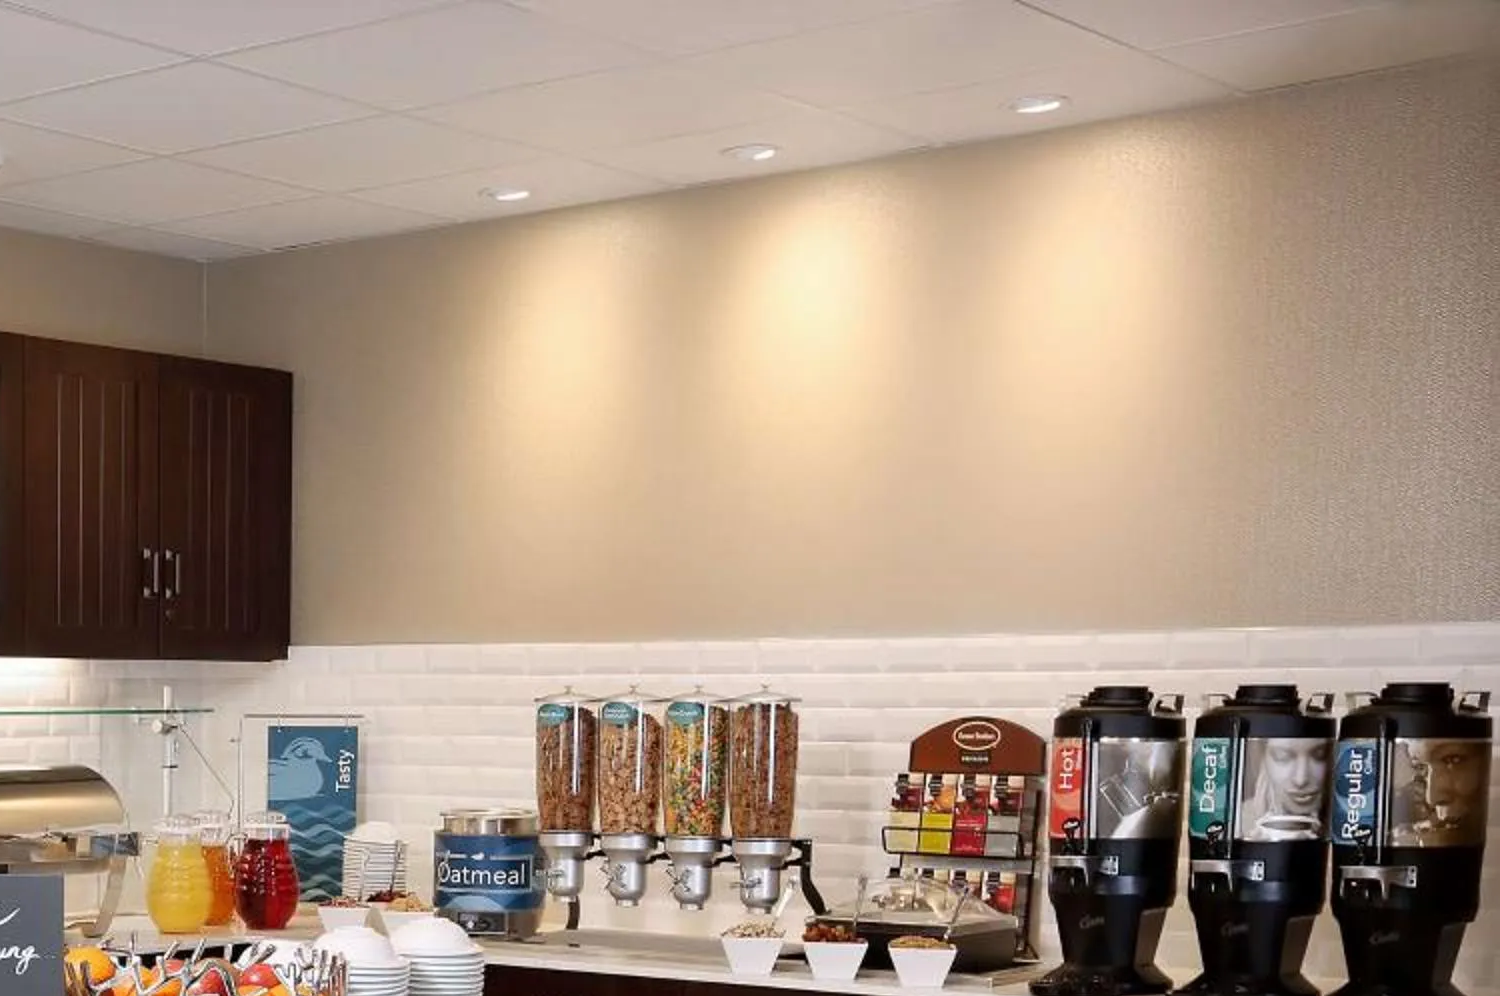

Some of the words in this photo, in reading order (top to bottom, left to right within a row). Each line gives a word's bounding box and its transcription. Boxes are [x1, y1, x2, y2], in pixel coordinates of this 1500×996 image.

[335, 749, 355, 793] Tasty
[1059, 748, 1074, 790] Hot
[1199, 743, 1217, 812] Decaf
[1341, 749, 1367, 838] Regular
[437, 861, 525, 886] Oatmeal
